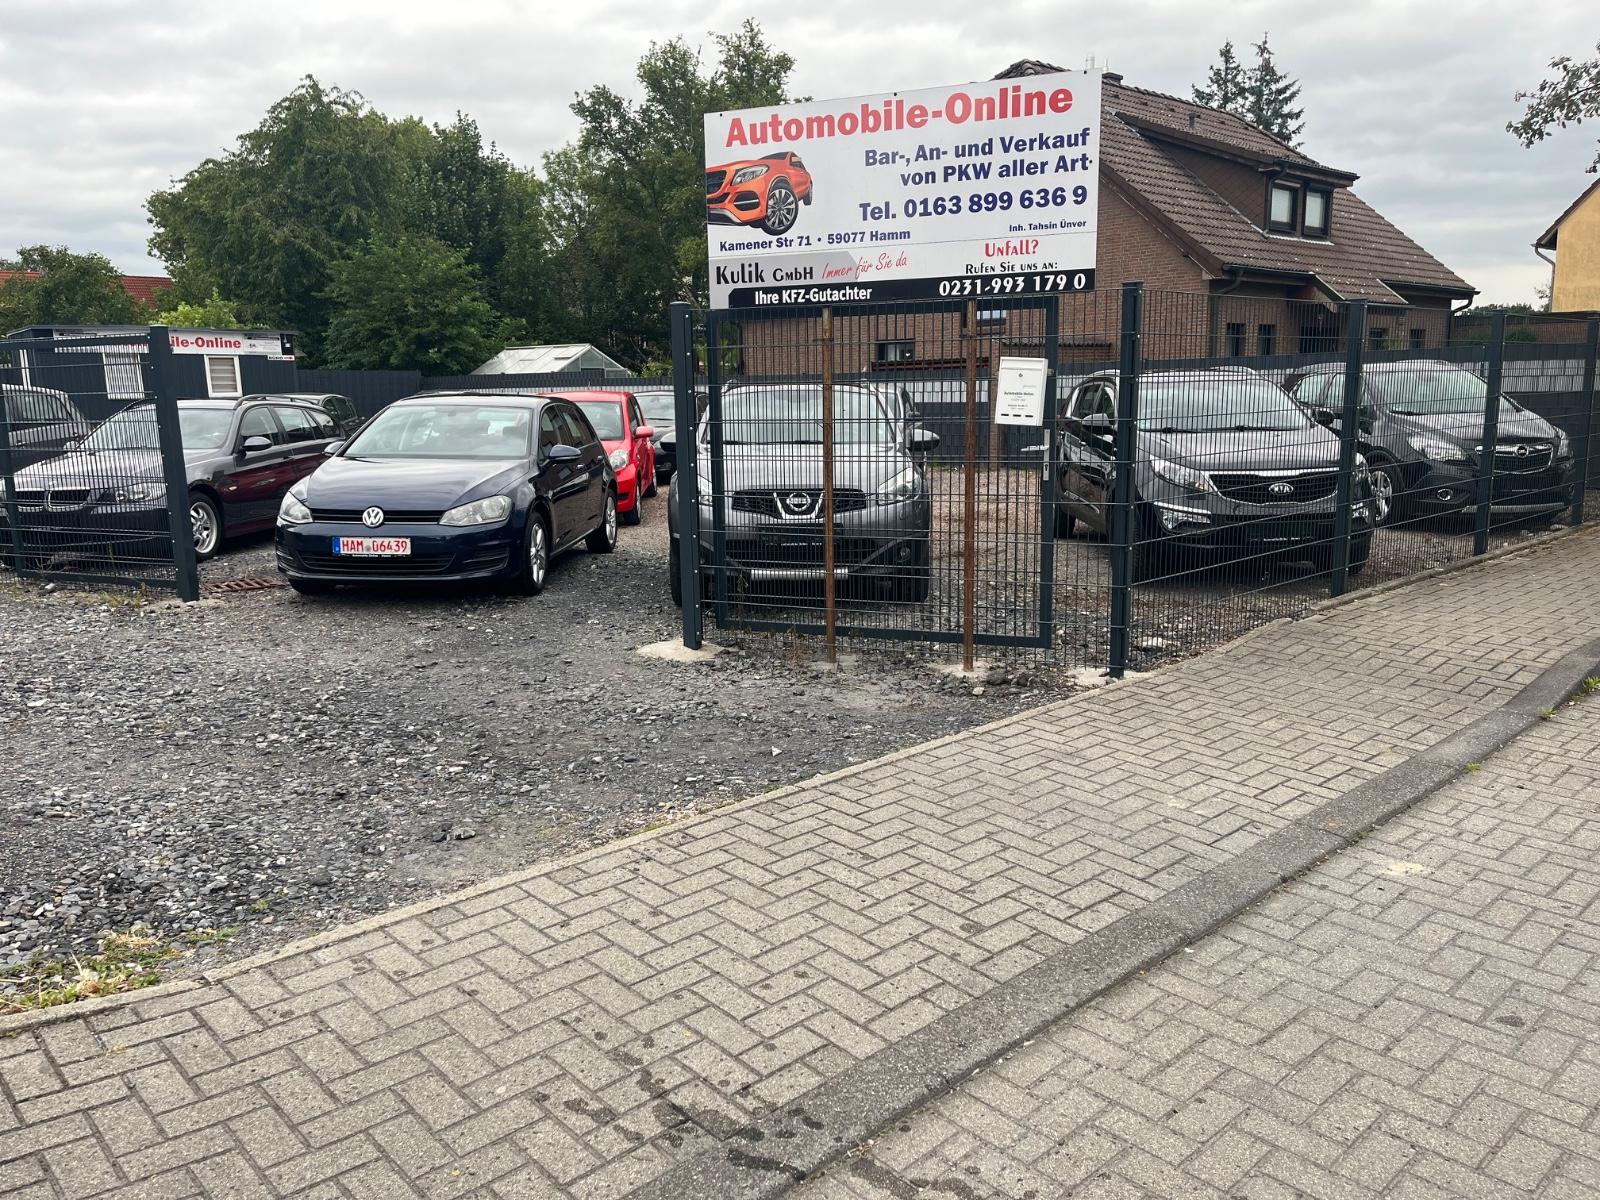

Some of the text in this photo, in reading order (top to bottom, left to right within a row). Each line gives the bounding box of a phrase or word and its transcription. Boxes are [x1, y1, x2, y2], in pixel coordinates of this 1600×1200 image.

[726, 85, 1073, 147] Automobile-Online
[915, 144, 948, 162] An-
[954, 138, 993, 157] und
[999, 127, 1091, 154] Verkauf
[900, 170, 936, 186] von
[943, 162, 992, 182] PKW
[998, 159, 1049, 178] aller
[859, 185, 1088, 221] Tel. 0163 899 636 9
[1009, 219, 1087, 232] Inh. Tahsin Ünver
[719, 229, 911, 252] Kamener Str 71 59077 Hamm
[716, 262, 814, 285] Kulik GmbH
[822, 251, 908, 280] Immer für Sie da
[999, 261, 1016, 273] Sie
[755, 286, 873, 305] Ihre KFZ-Gutachter
[939, 273, 1086, 297] 0231-993 179 0
[170, 336, 241, 349] ile-Online
[342, 540, 364, 552] HAM
